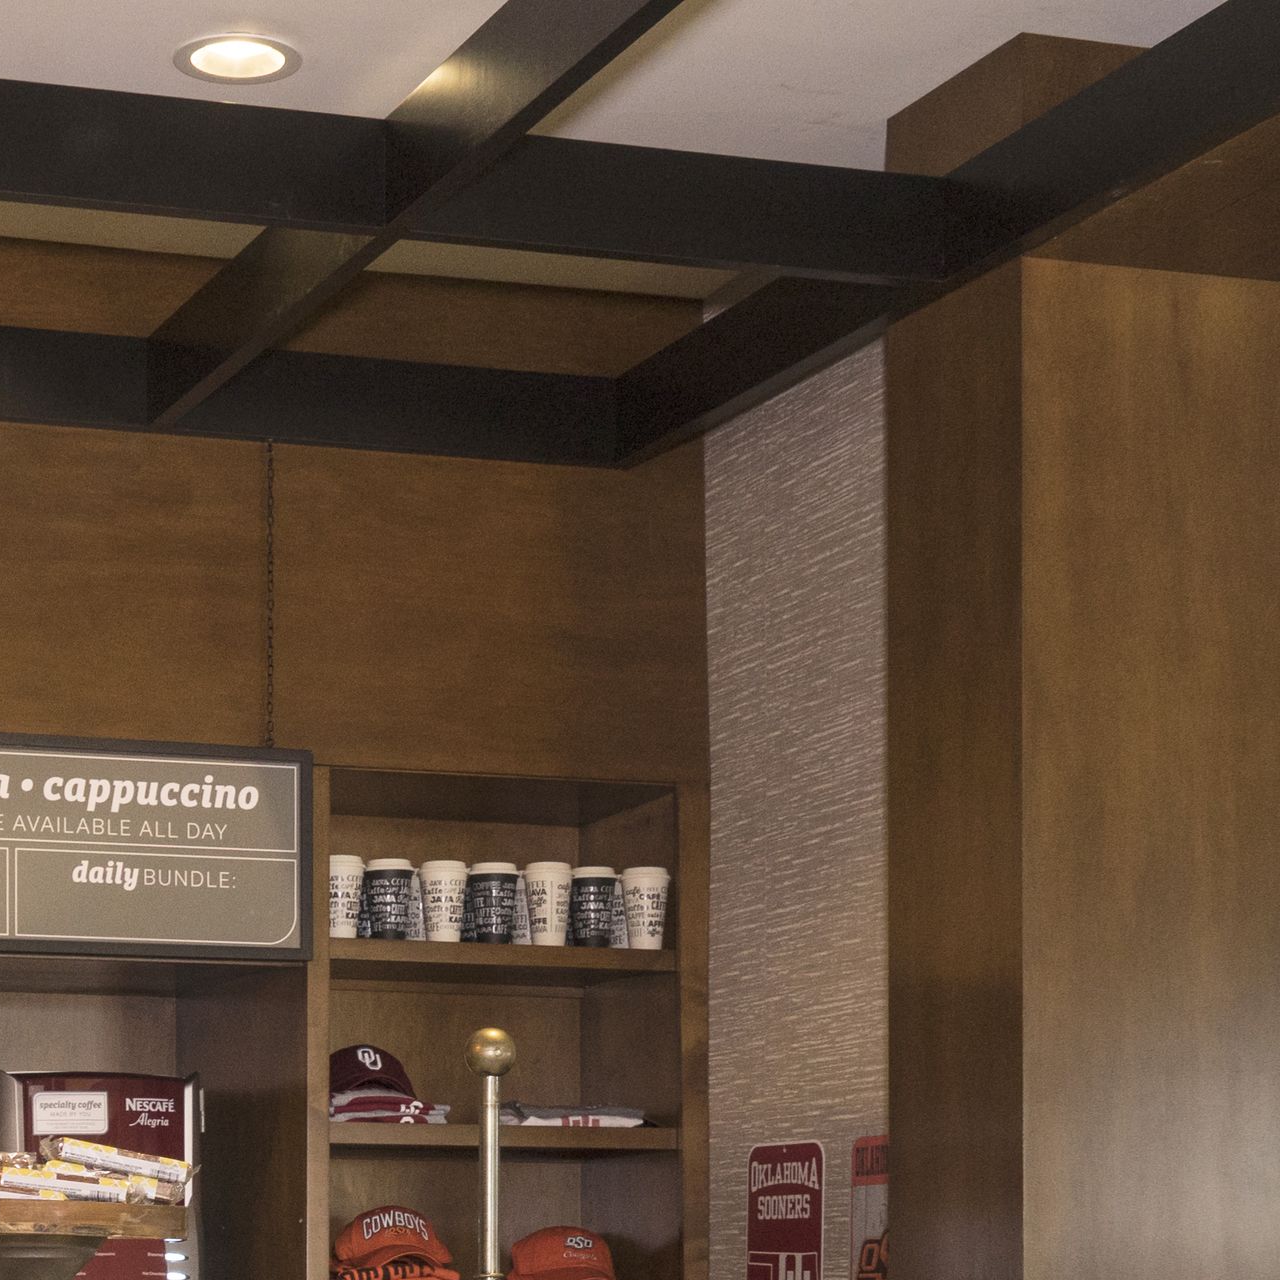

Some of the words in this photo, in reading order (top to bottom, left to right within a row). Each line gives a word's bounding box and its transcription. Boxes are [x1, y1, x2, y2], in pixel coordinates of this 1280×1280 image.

[42, 772, 261, 812] cappuccino
[12, 814, 133, 837] AVAILABLE
[139, 819, 182, 840] ALL
[186, 821, 228, 841] DAY
[71, 859, 140, 892] daily
[143, 868, 238, 890] BUNDLE:
[39, 1100, 77, 1111] specialty
[77, 1099, 103, 1111] coffee
[125, 1097, 175, 1112] NESCAFÉ
[129, 1112, 169, 1128] Alegria
[751, 1157, 820, 1193] OKLAHOMA
[757, 1194, 811, 1220] SOONERS
[362, 1209, 429, 1242] COWBOYS
